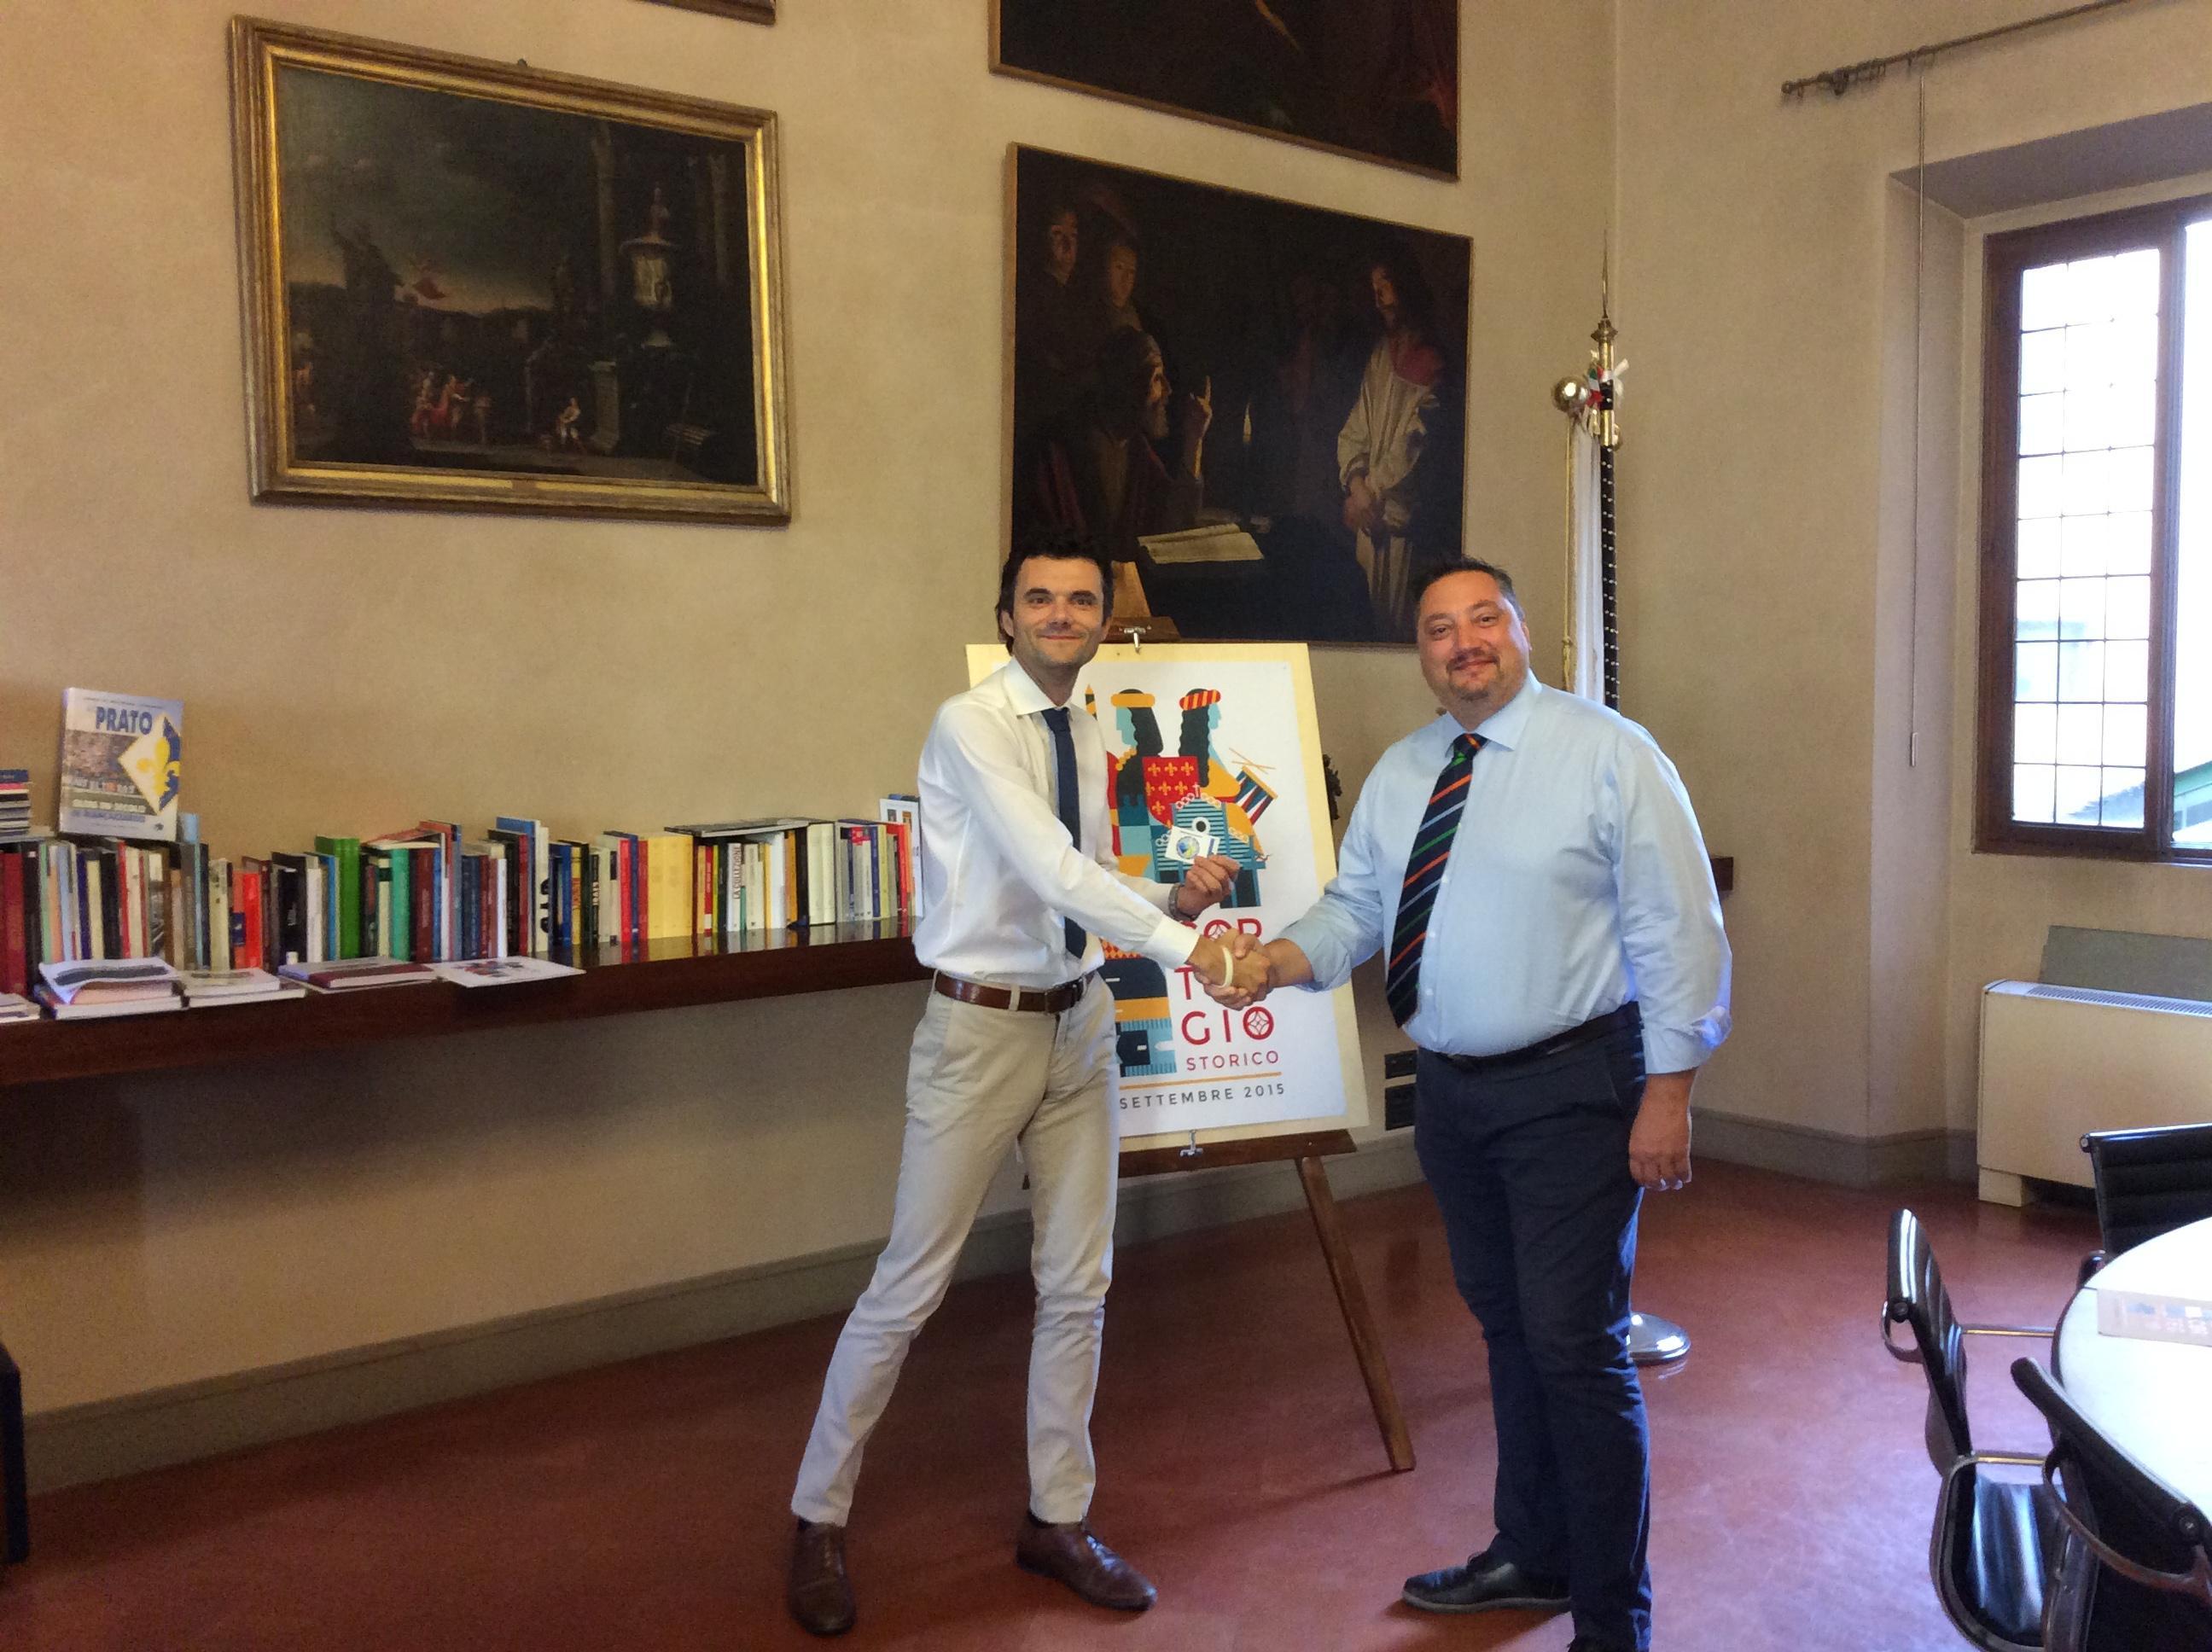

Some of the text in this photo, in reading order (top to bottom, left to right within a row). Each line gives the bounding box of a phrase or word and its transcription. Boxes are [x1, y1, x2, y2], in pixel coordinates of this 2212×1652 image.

[96, 707, 152, 735] PRATO
[1181, 1006, 1274, 1045] GIO
[1186, 1050, 1278, 1071] STORICO
[1120, 1084, 1284, 1109] SETTEMBRE 2015
